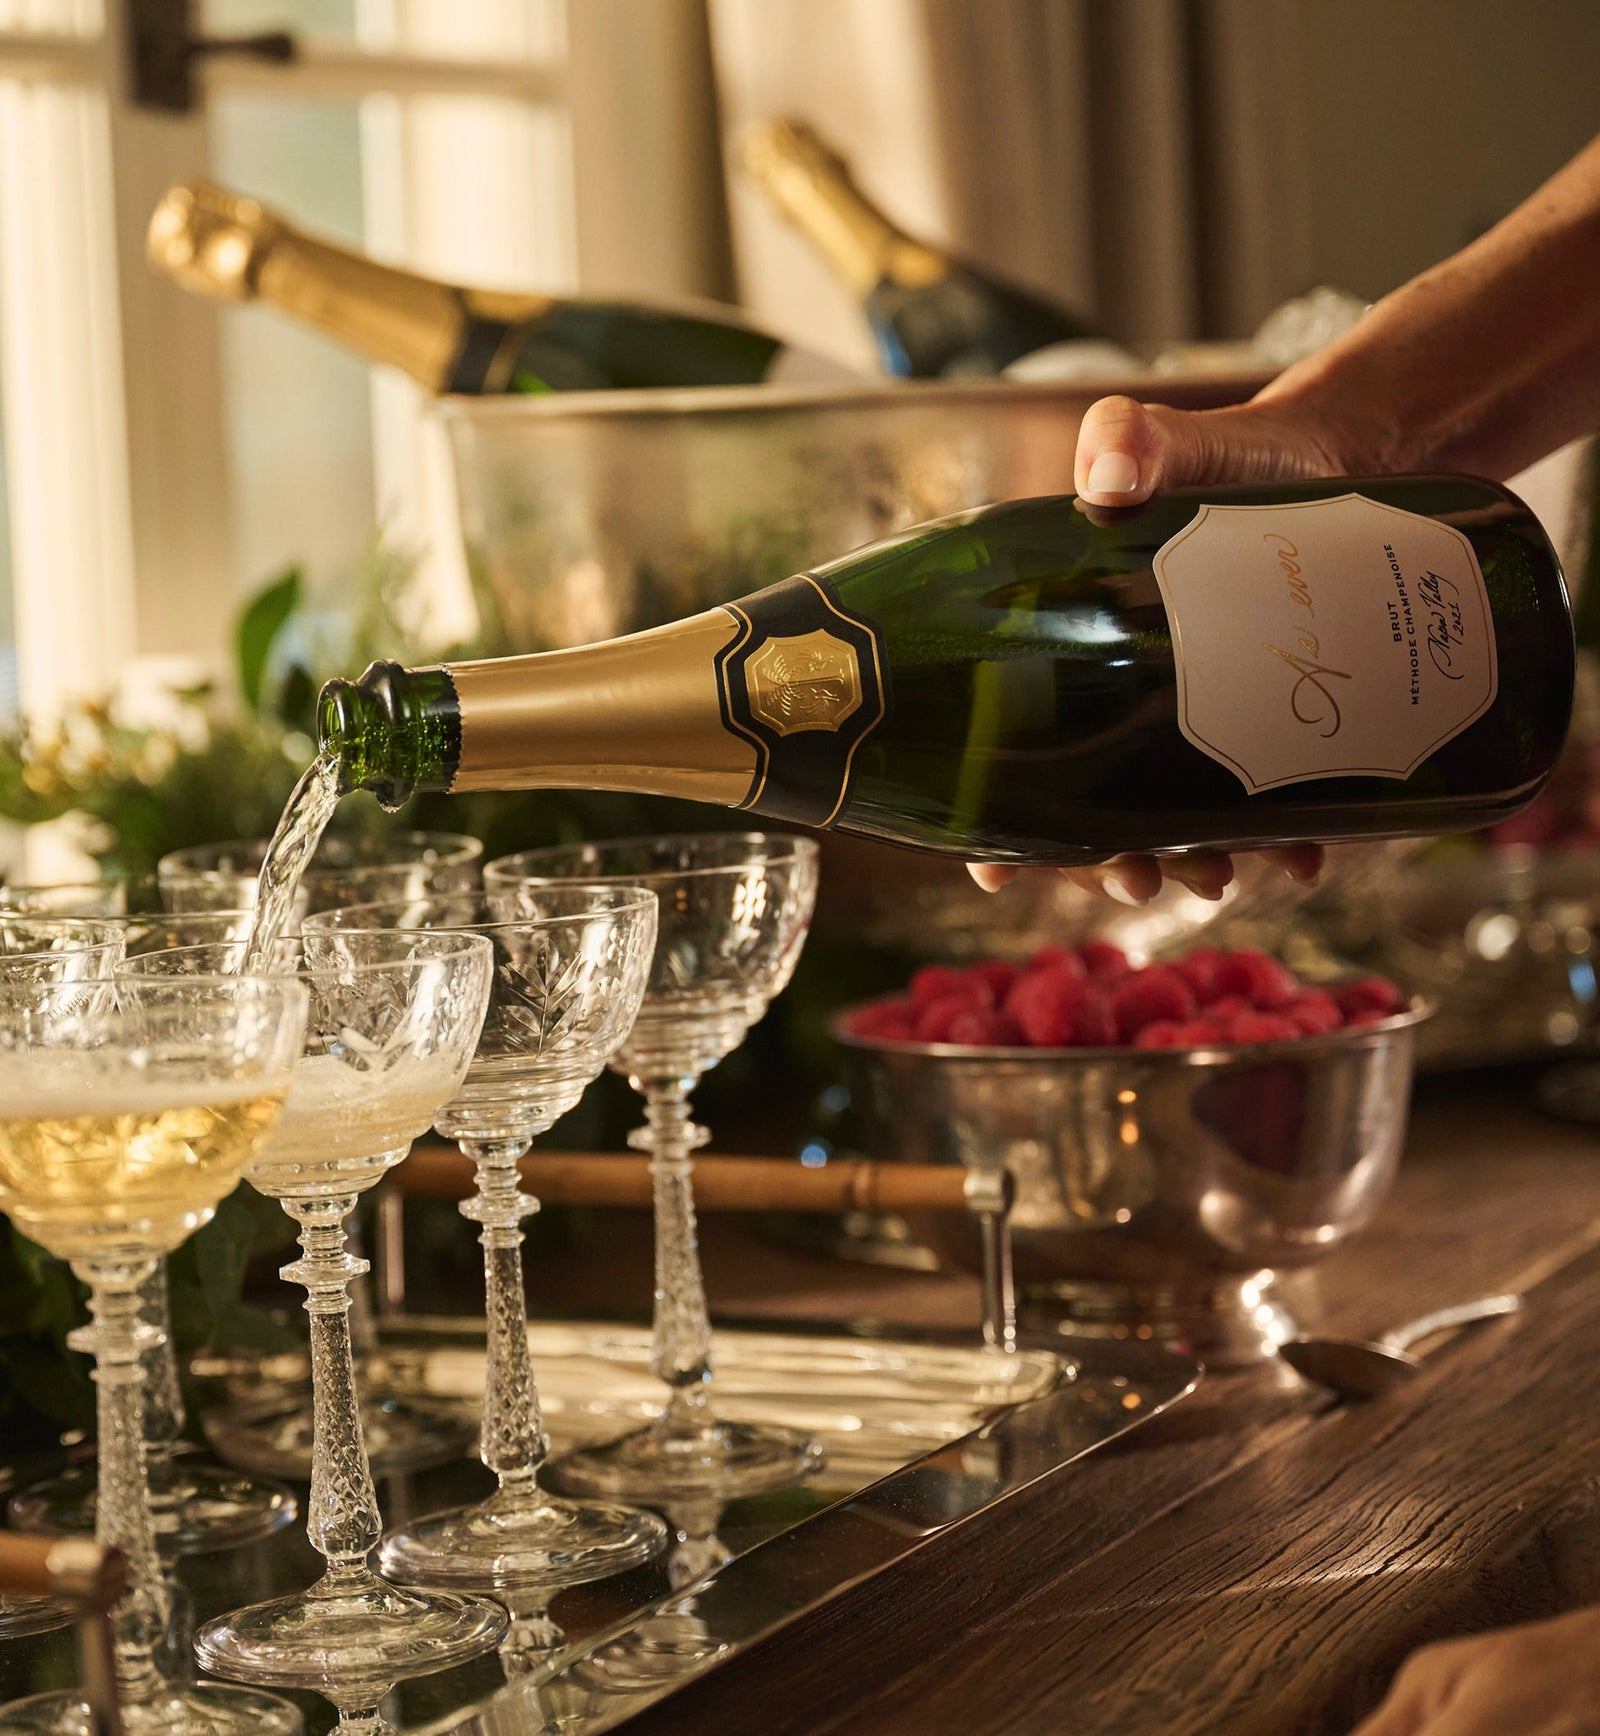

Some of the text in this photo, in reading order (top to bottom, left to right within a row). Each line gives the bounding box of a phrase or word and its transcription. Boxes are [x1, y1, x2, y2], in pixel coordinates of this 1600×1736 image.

[1263, 533, 1352, 738] As ever
[1383, 544, 1420, 705] MÉTHODE CHAMPENOISE
[1387, 601, 1402, 642] BRUT
[1417, 570, 1465, 680] Napa Valley
[1448, 602, 1465, 636] 2021
